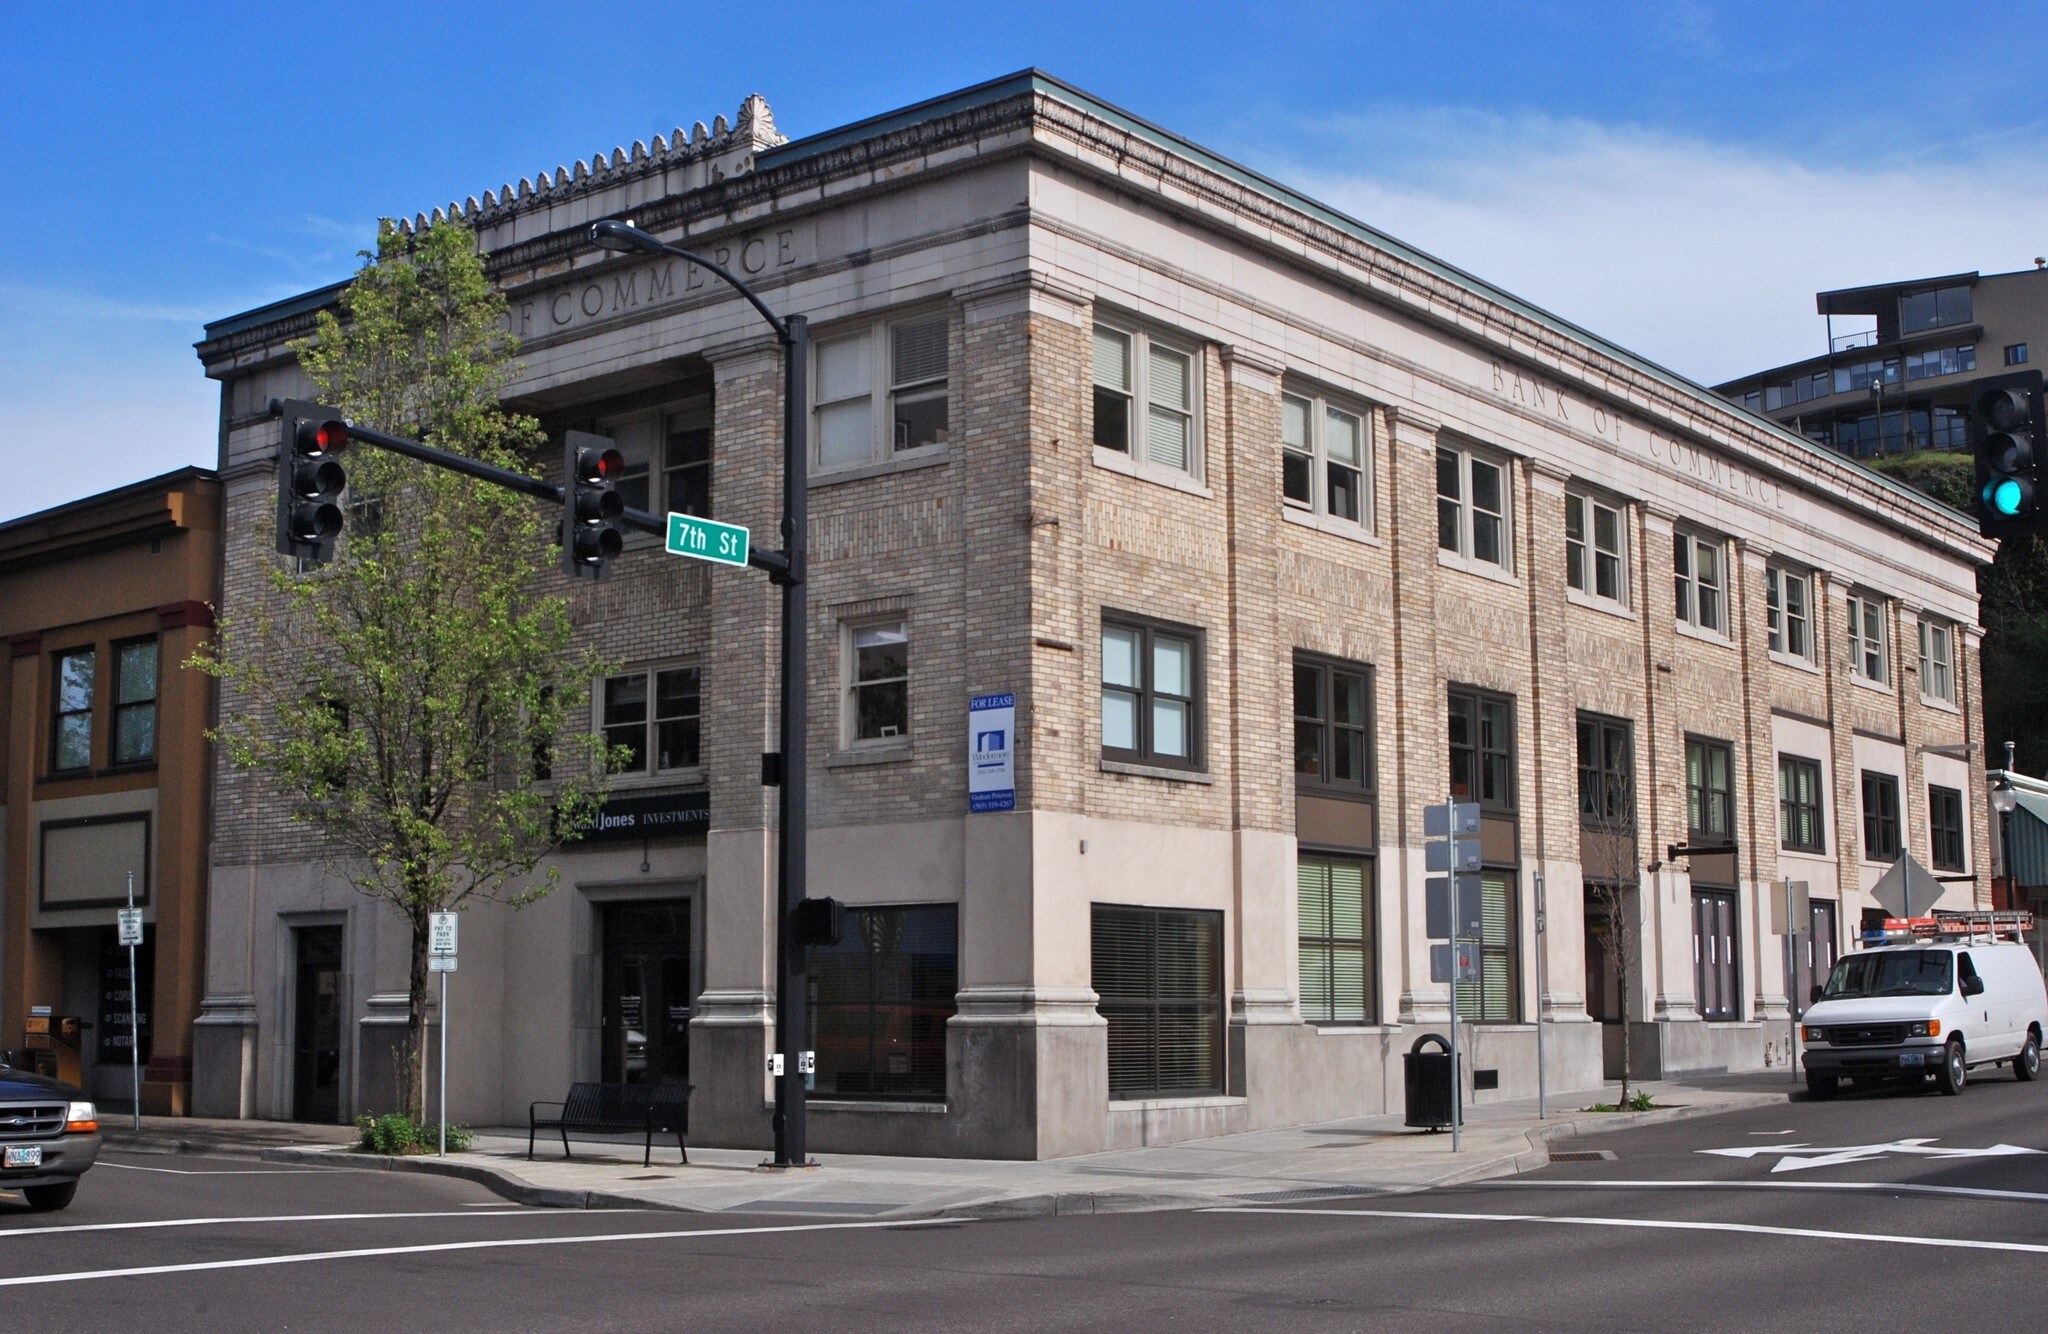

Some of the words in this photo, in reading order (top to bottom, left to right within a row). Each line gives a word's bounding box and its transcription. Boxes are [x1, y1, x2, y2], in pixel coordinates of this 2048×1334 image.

[551, 229, 797, 325] COMMERCE
[1492, 361, 1570, 420] BANK
[1593, 406, 1622, 442] OF
[1649, 430, 1785, 510] COMMERCE
[679, 522, 706, 550] 7th
[719, 531, 738, 557] St
[970, 698, 986, 709] FOR
[988, 695, 1014, 707] LEASE
[599, 812, 635, 831] Jones
[643, 808, 710, 825] INVESTMENTS
